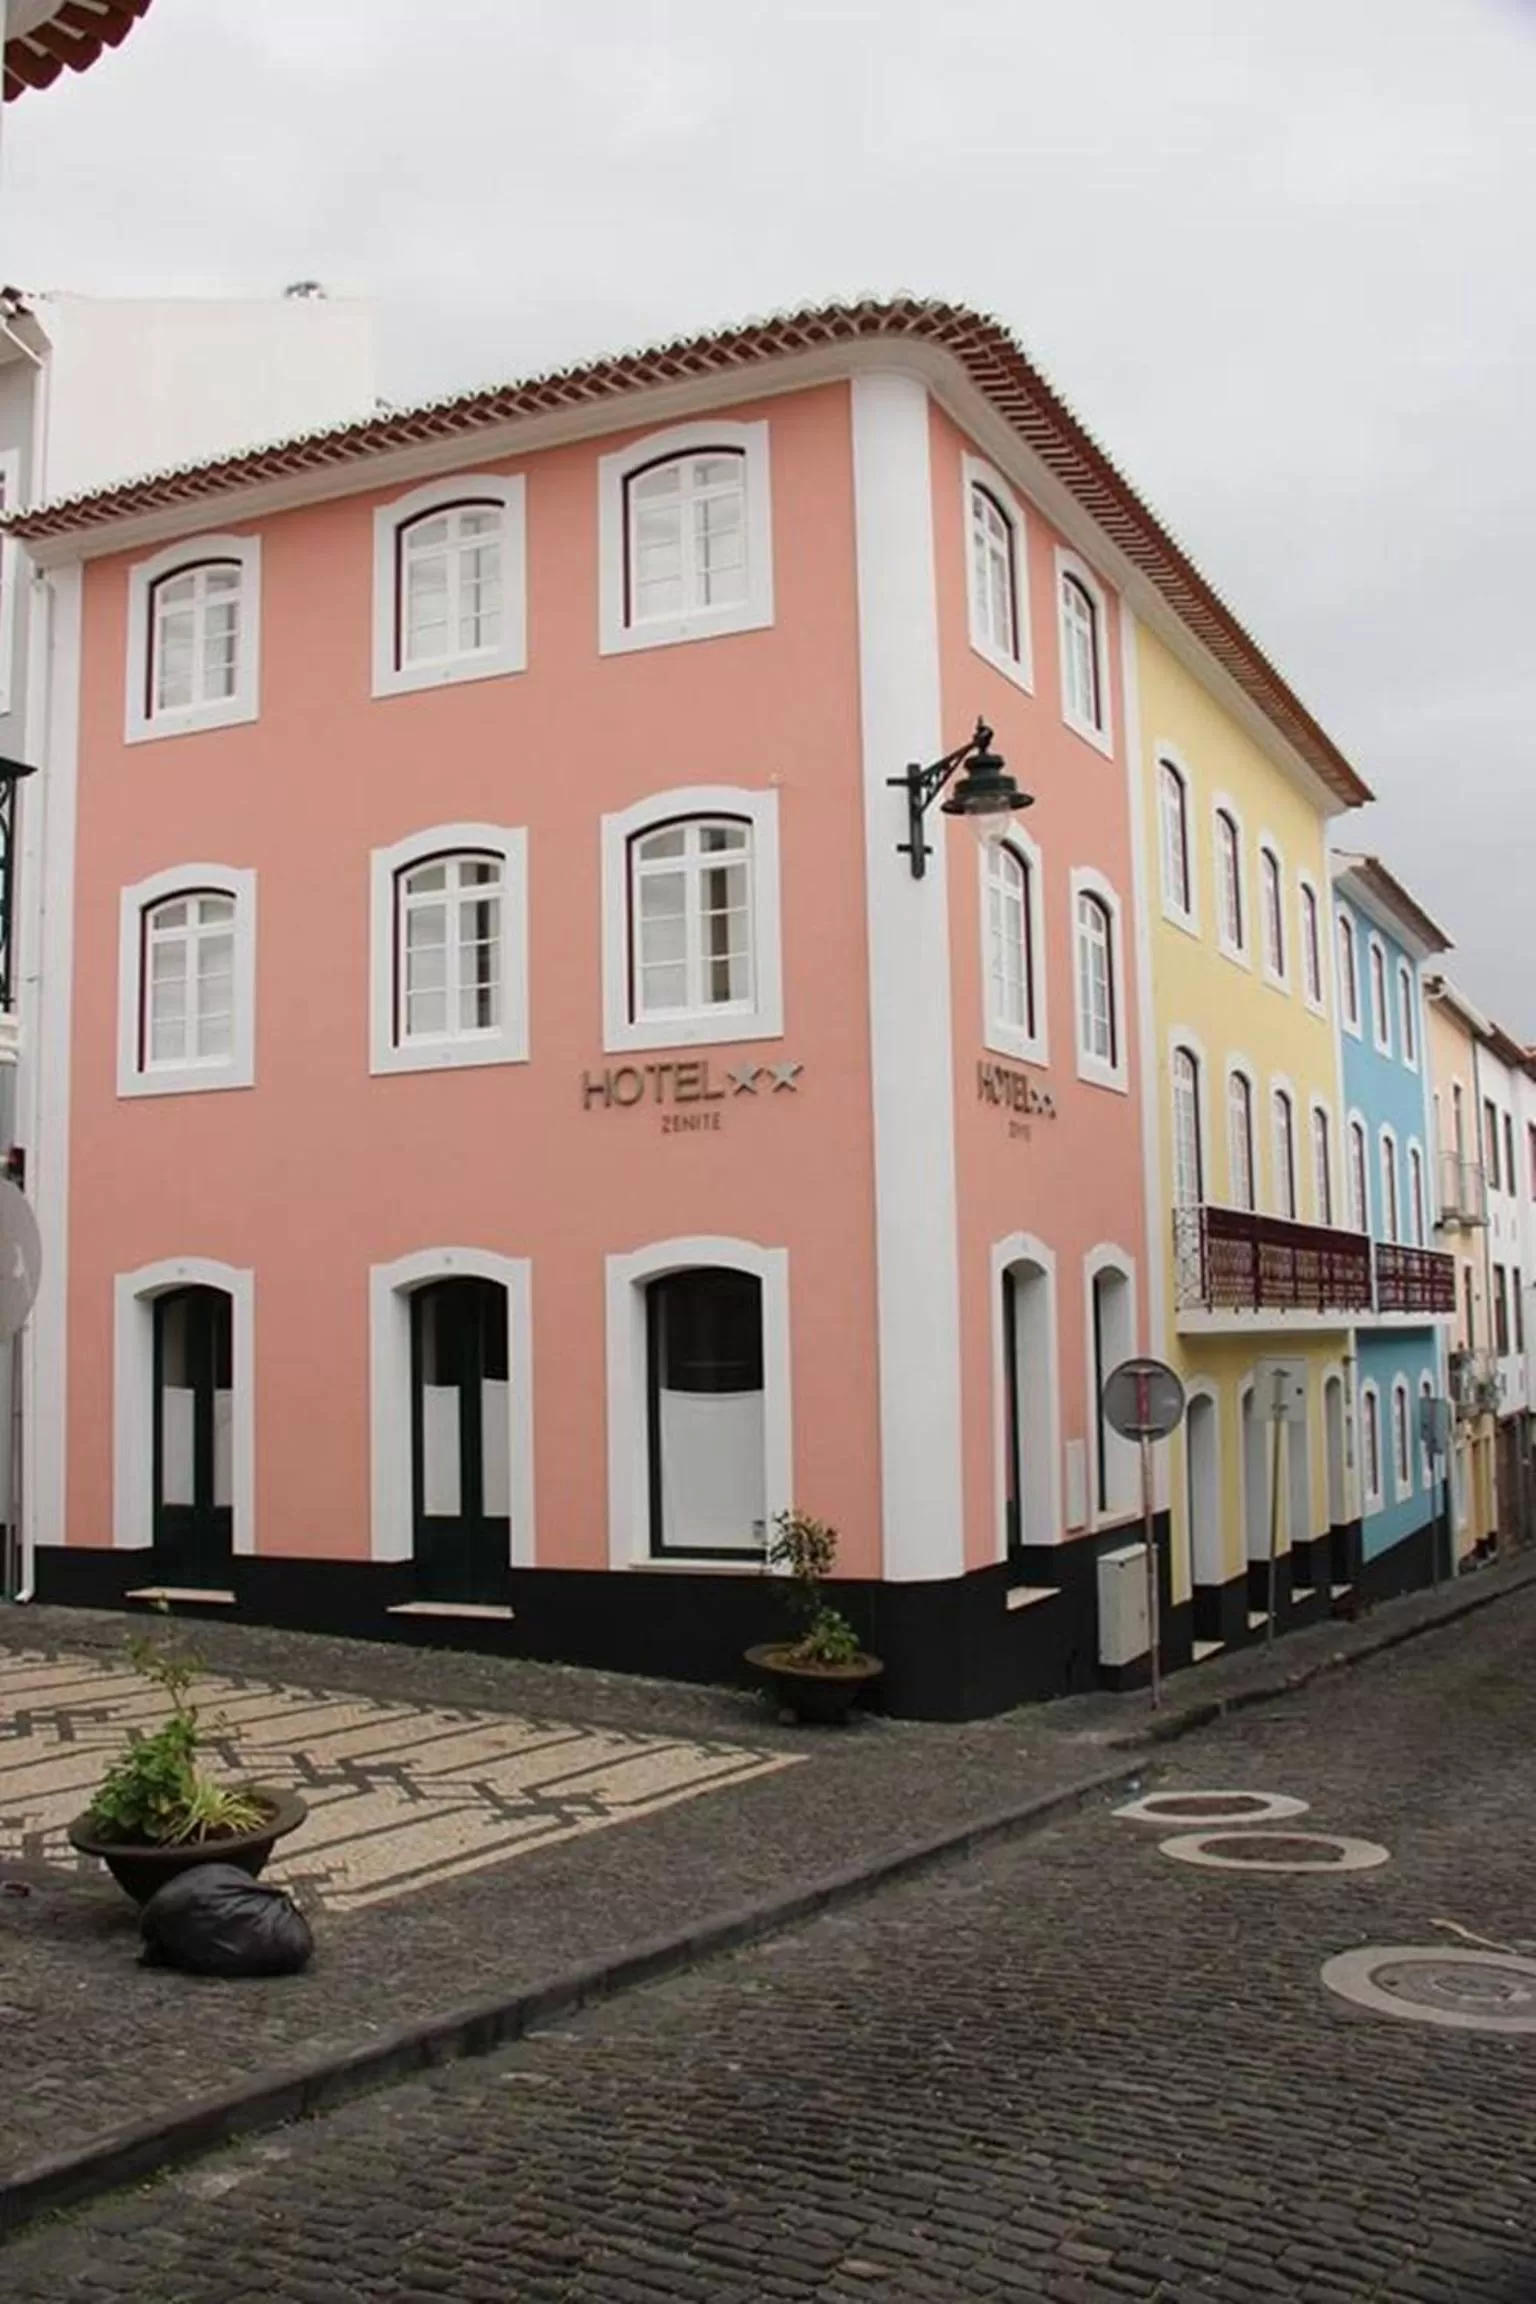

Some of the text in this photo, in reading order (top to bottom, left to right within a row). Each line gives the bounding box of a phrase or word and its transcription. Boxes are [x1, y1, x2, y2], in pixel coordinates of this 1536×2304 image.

[582, 1061, 725, 1110] HOTEL
[976, 1060, 1032, 1114] HOTEL
[661, 1112, 721, 1133] ZENITE
